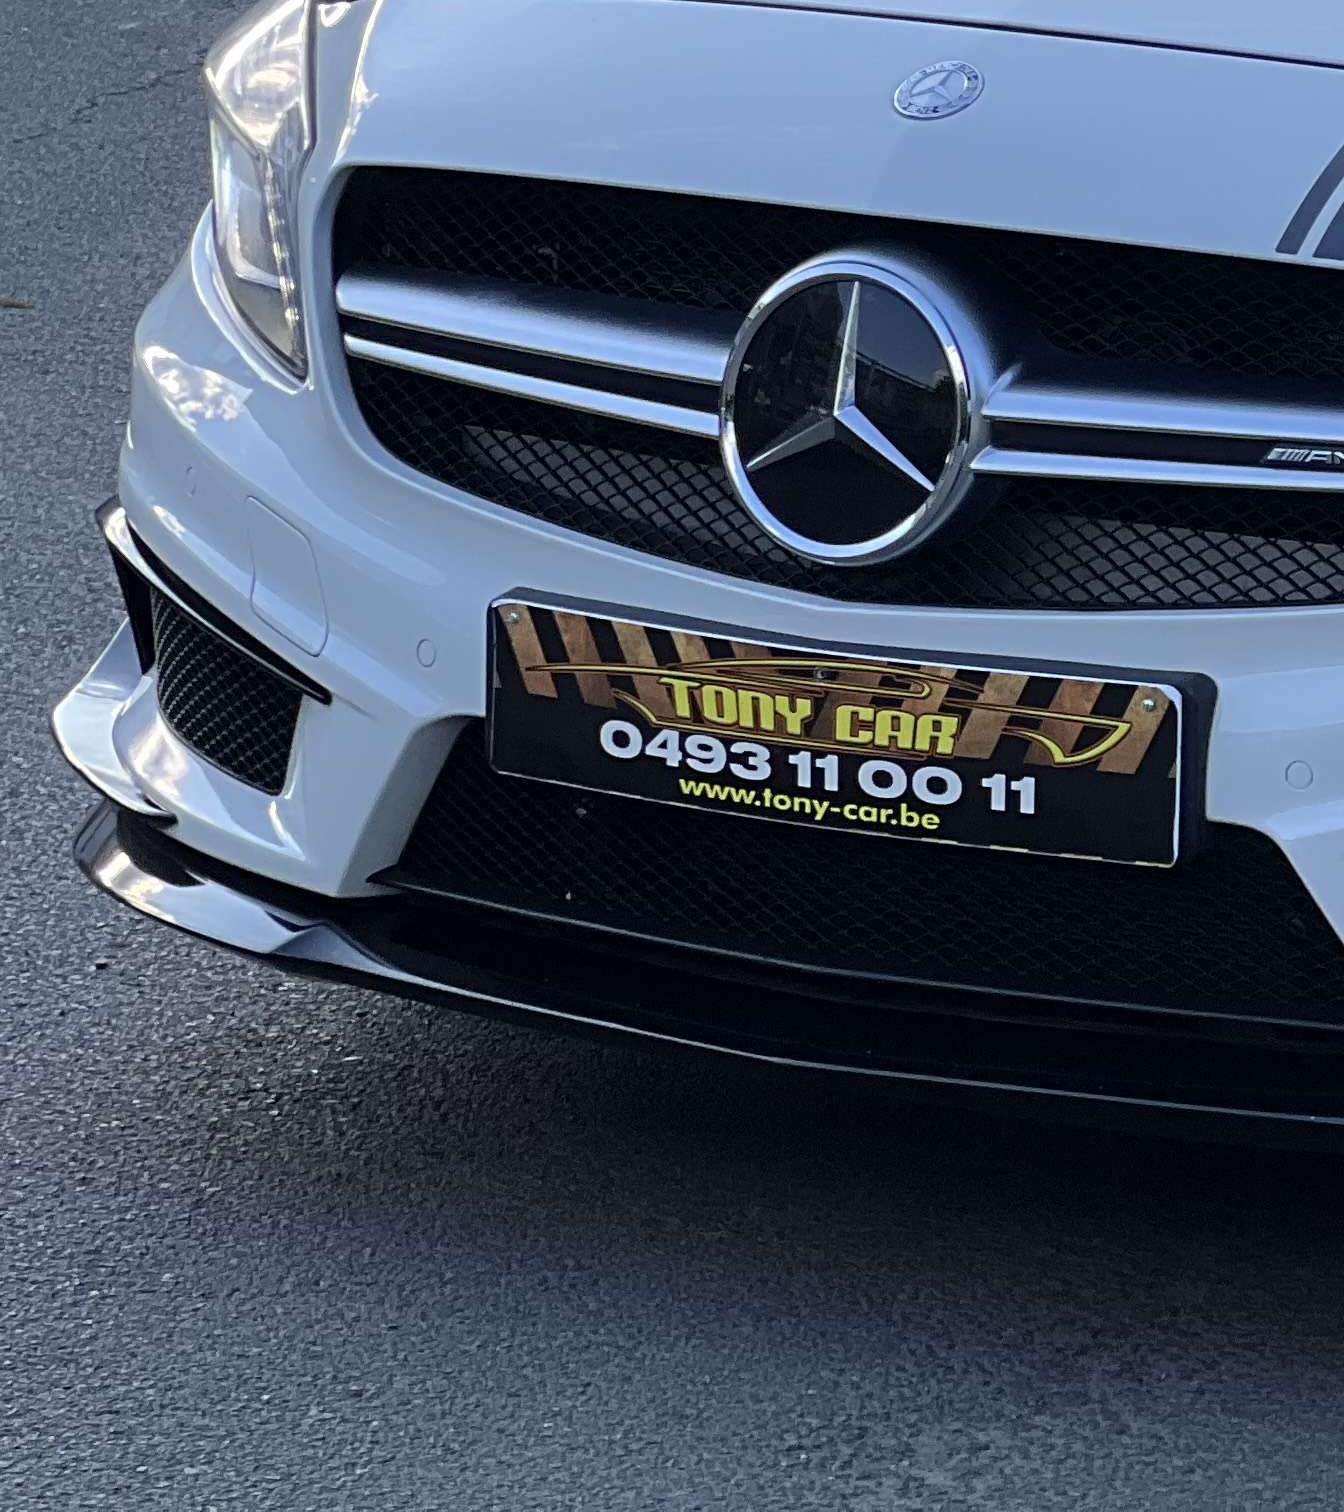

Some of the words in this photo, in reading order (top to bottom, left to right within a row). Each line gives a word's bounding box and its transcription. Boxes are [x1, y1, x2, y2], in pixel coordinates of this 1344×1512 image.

[657, 675, 812, 736] TONY
[835, 703, 959, 755] CAR
[599, 719, 772, 781] 0493
[788, 750, 840, 791] 11
[857, 759, 963, 806] 00
[981, 773, 1037, 815] 11
[678, 778, 941, 831] www.tony-car.be
